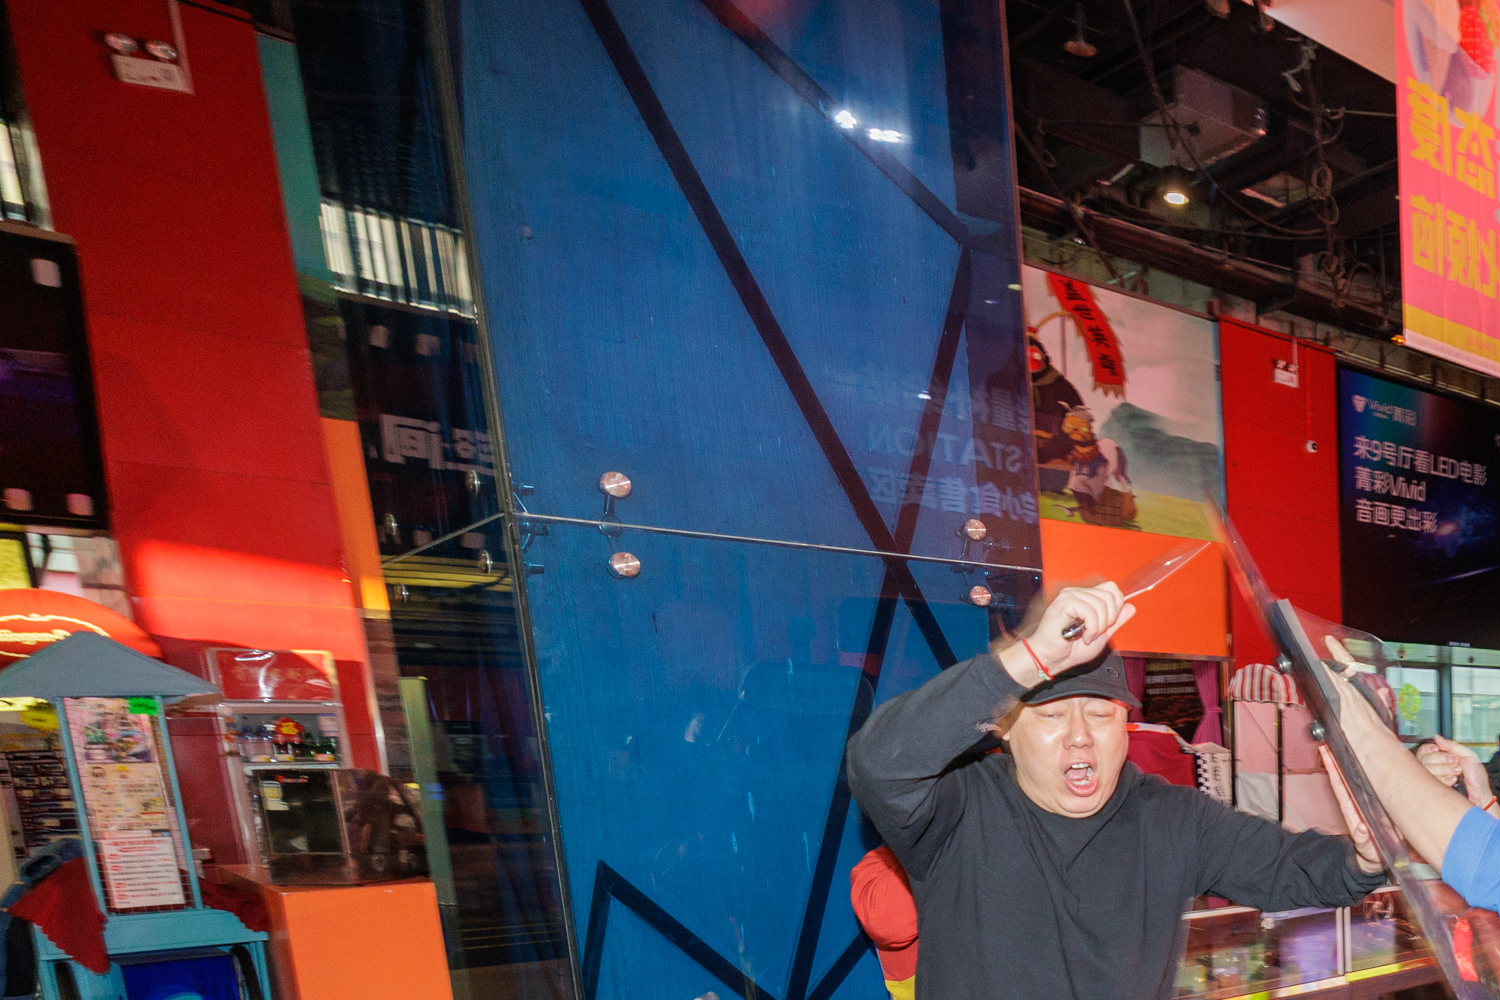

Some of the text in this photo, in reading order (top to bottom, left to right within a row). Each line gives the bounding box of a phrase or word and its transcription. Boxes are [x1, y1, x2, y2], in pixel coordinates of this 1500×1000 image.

[1353, 435, 1487, 487] 来9号厅看LED电影
[1355, 498, 1437, 534] 音画更出彩
